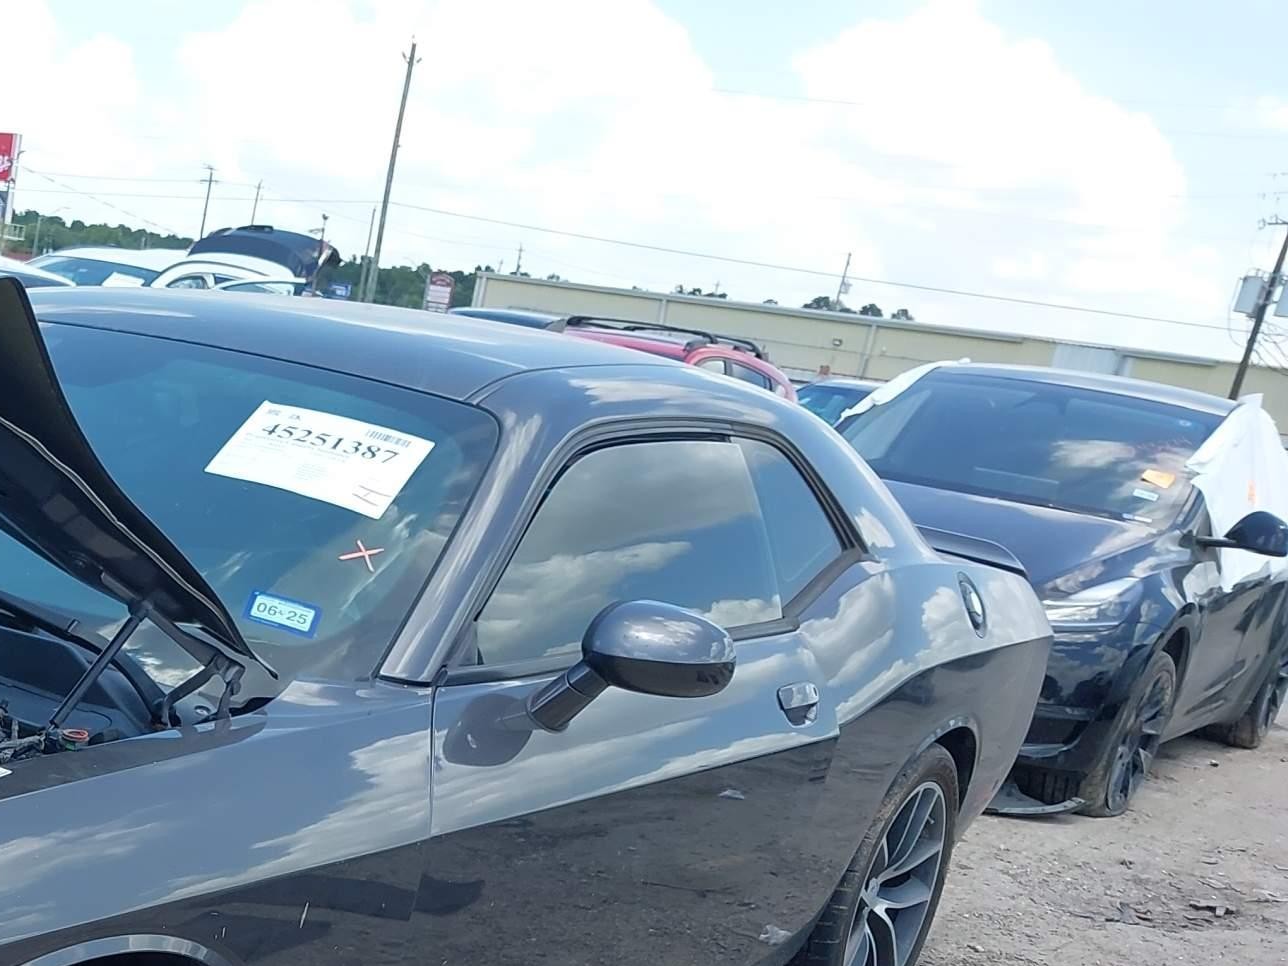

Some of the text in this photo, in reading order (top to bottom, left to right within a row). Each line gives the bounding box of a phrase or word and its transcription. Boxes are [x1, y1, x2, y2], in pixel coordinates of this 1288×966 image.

[261, 423, 400, 464] 45251387
[256, 602, 309, 625] 06 25
